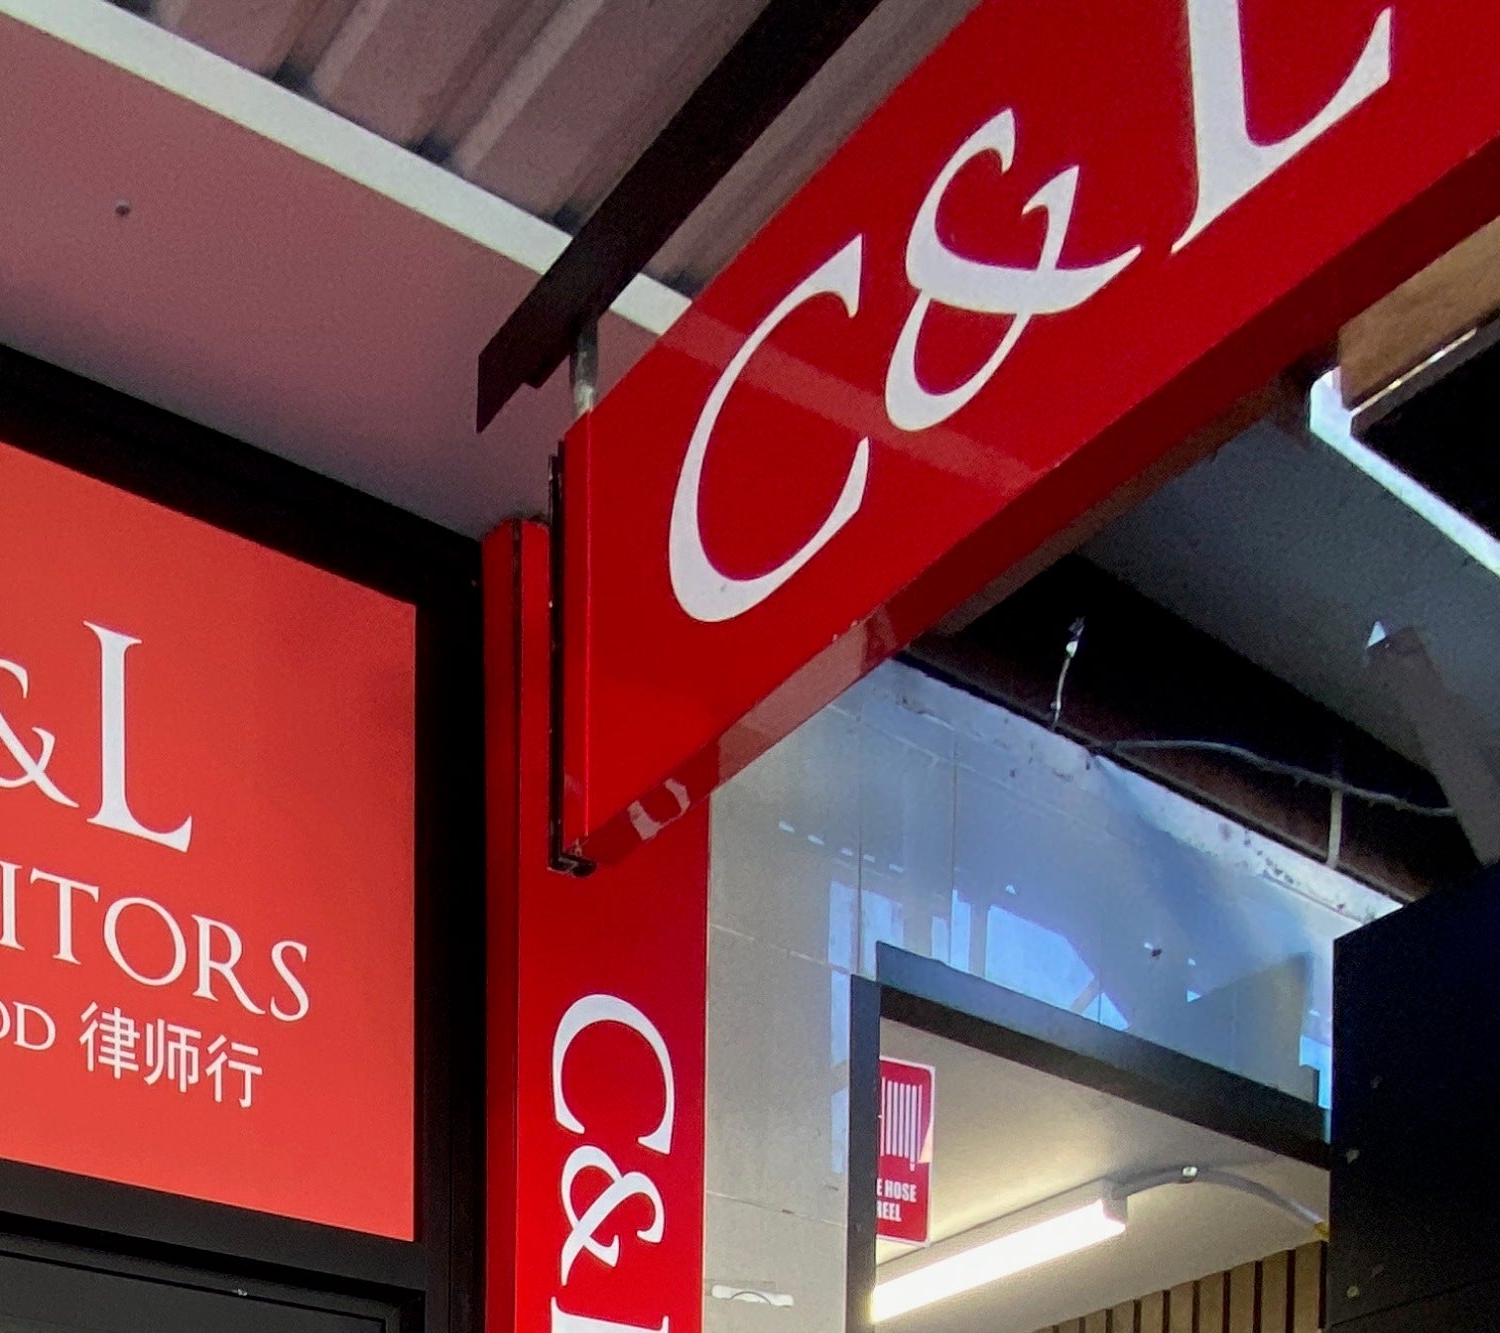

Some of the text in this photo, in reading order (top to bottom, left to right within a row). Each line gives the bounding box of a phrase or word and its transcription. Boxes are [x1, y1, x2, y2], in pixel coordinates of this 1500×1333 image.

[668, 0, 1392, 621] C&L
[80, 1002, 264, 1109] 律师行
[884, 1178, 917, 1203] HOSE
